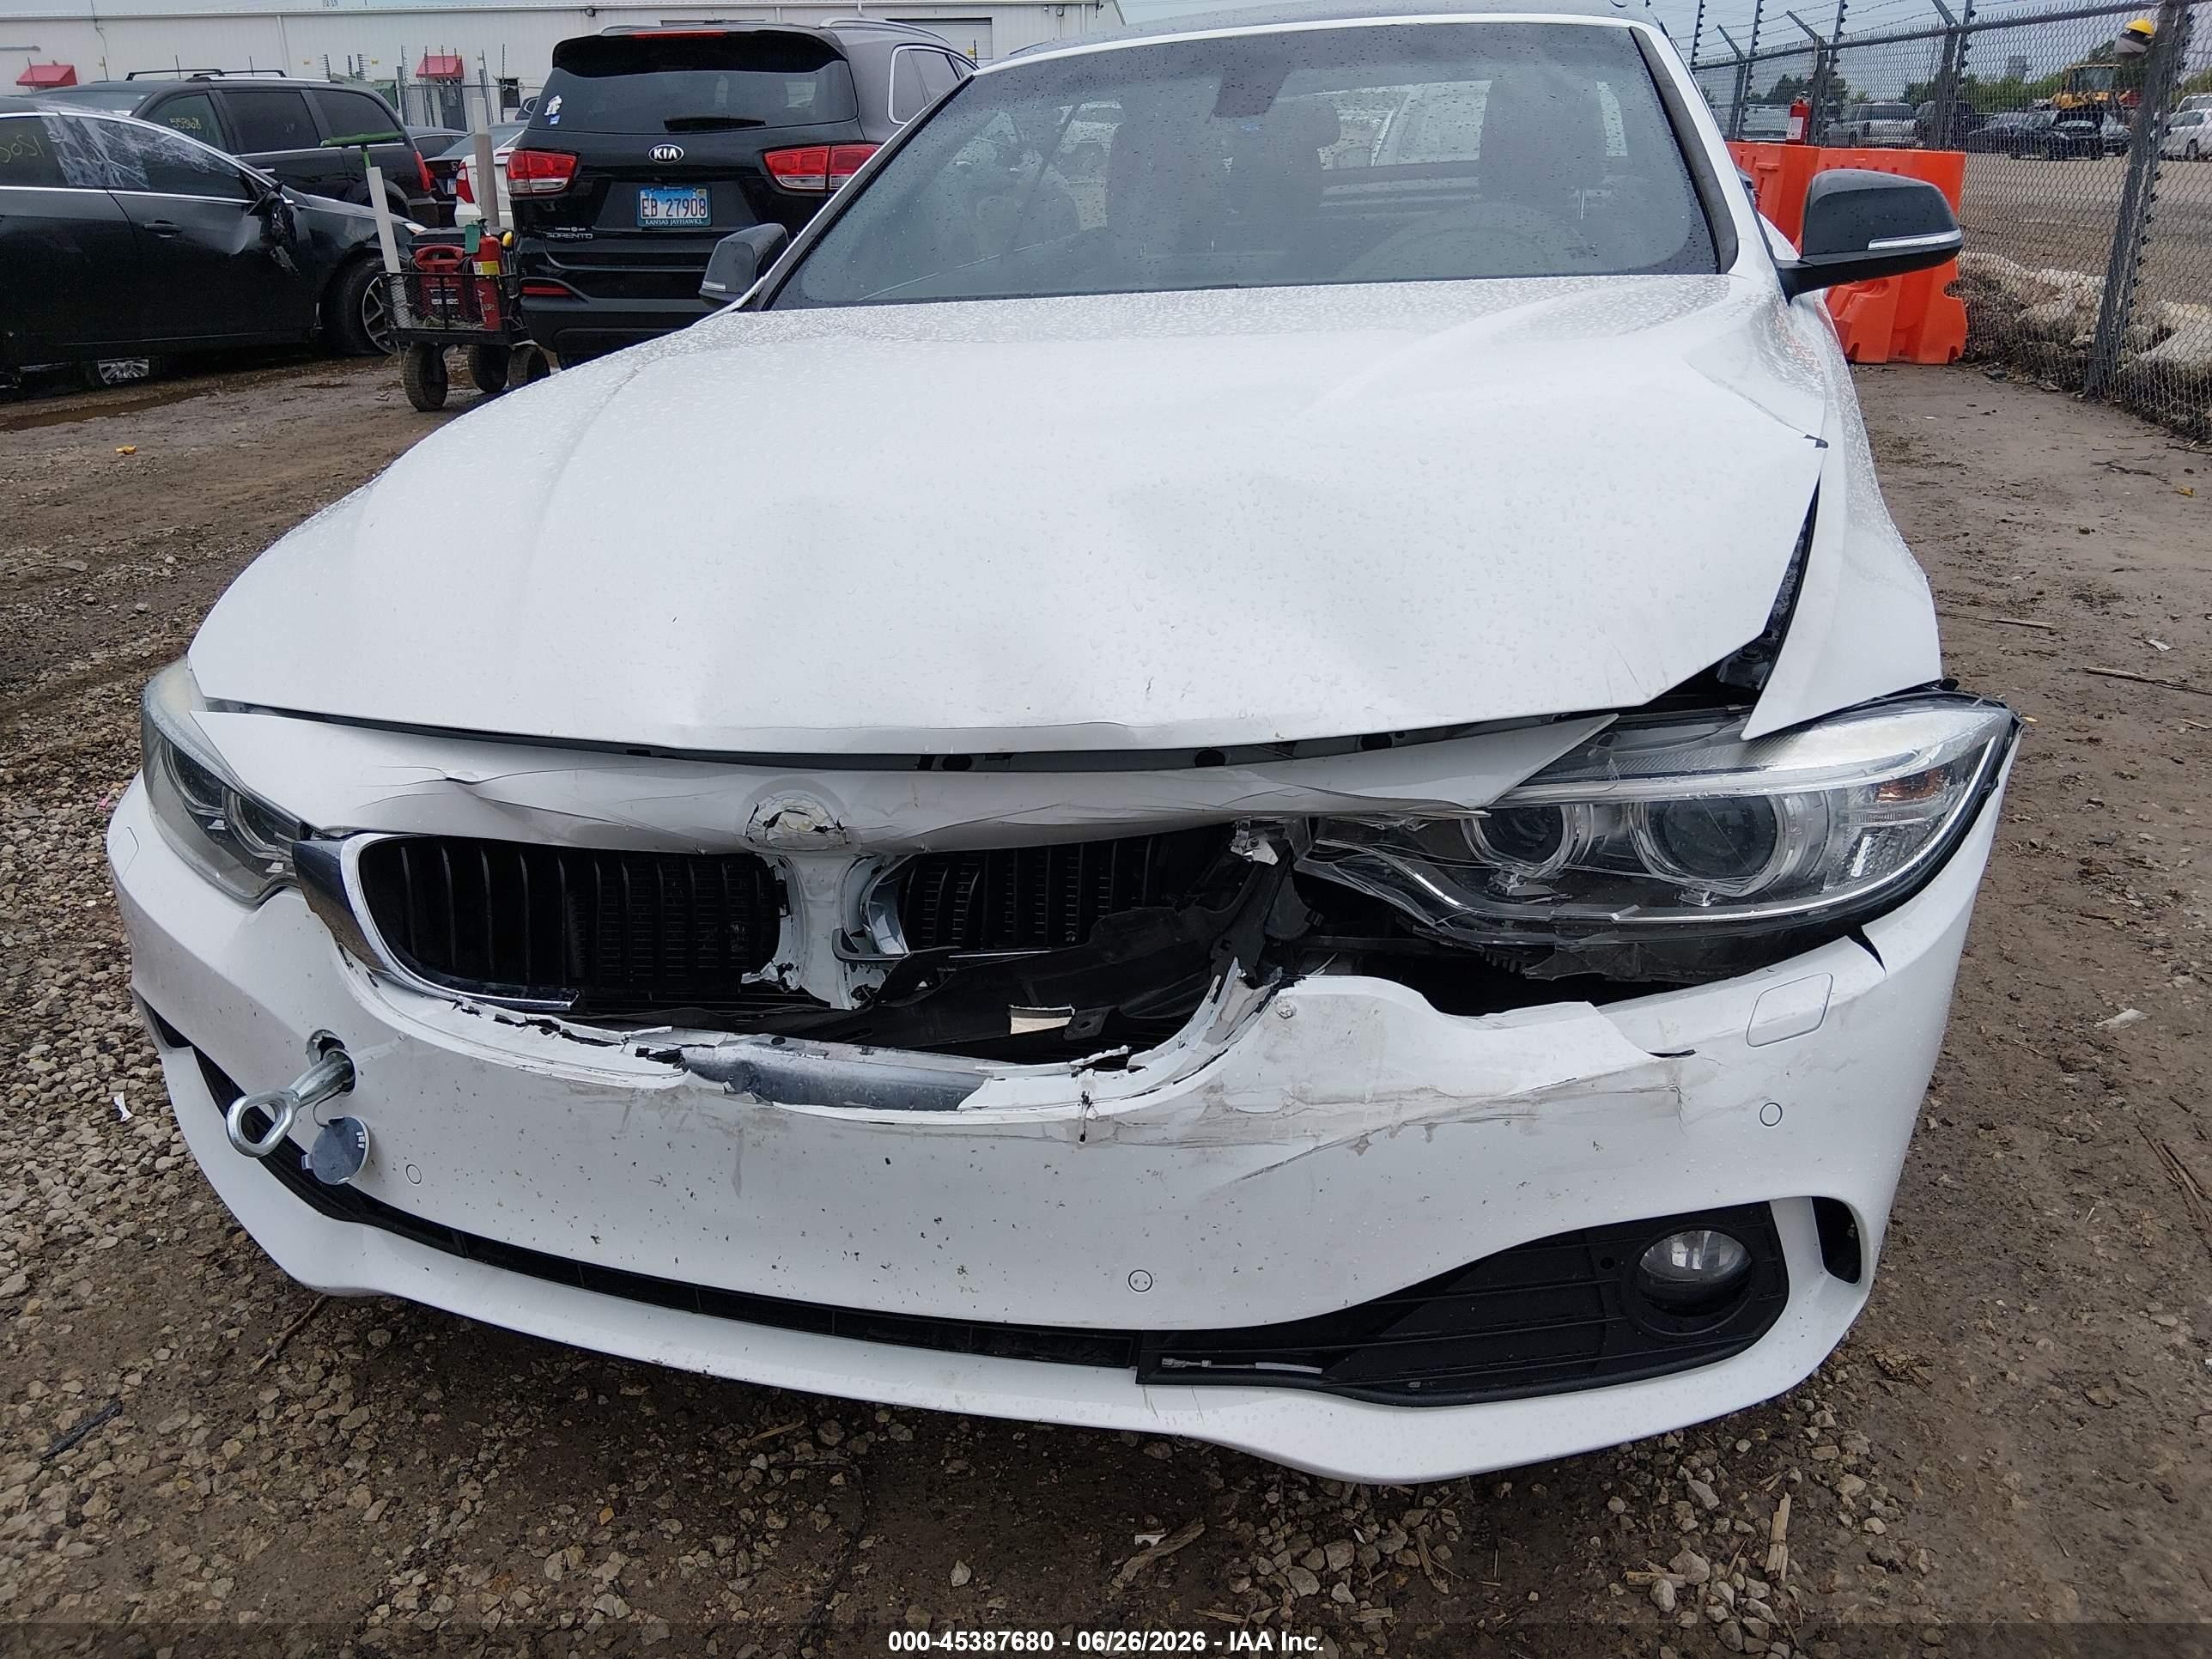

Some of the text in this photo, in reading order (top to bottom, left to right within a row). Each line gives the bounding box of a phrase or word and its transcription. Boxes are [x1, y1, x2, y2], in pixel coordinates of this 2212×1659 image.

[653, 148, 678, 160] KIA
[641, 198, 707, 218] EB 27908
